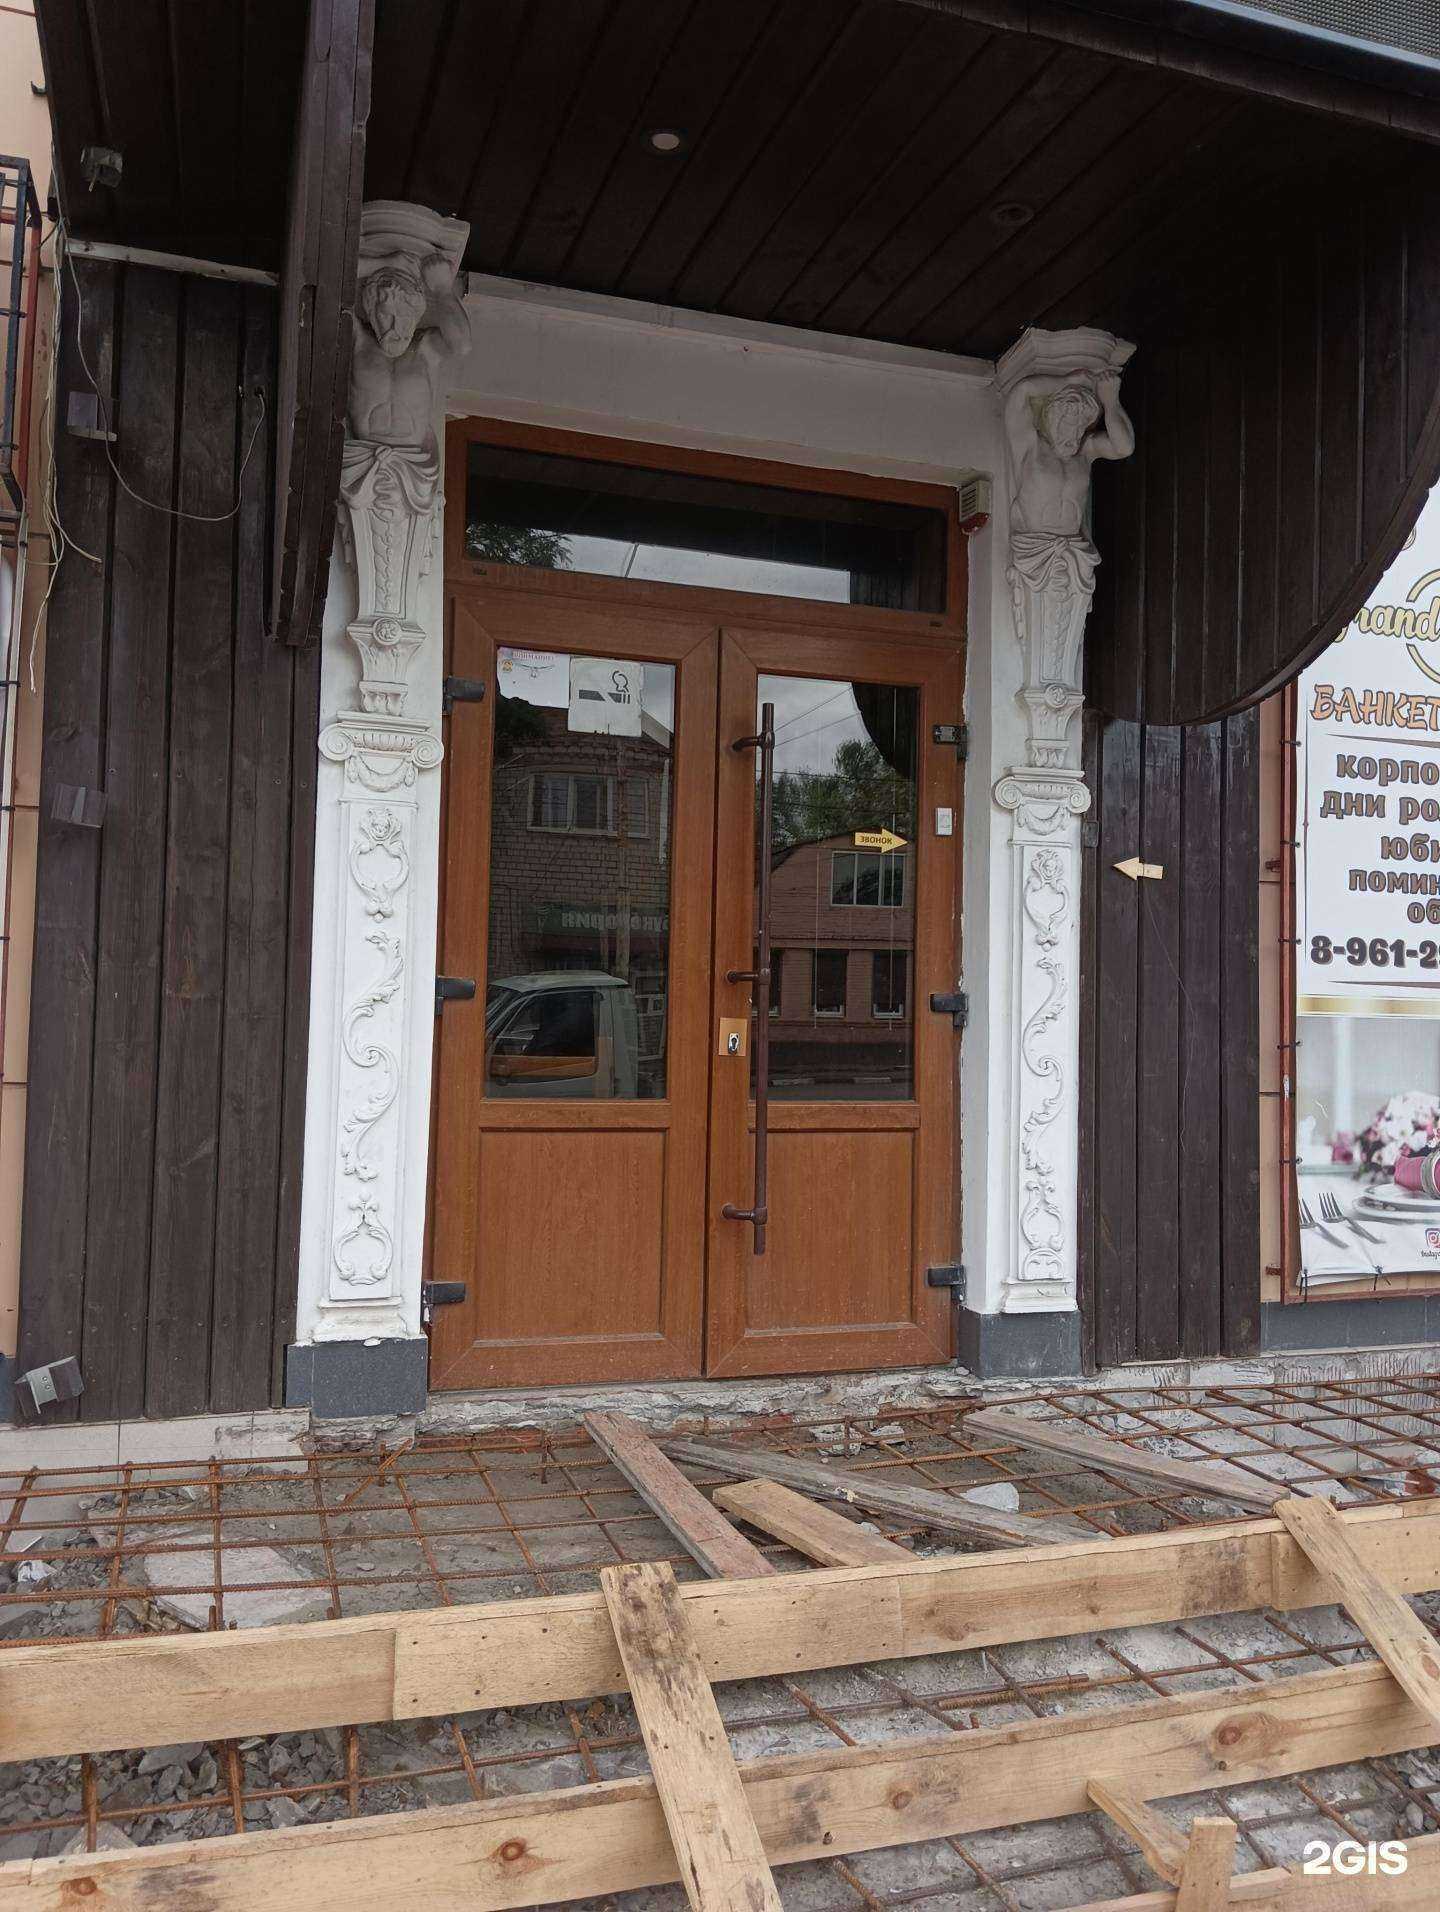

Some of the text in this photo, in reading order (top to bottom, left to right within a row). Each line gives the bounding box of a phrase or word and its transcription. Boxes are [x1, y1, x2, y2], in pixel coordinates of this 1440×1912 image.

[1333, 596, 1440, 643] rand
[1310, 684, 1440, 731] БАНКЕТ
[1320, 791, 1440, 825] дни ро
[859, 835, 893, 845] ЗВОНОК
[1310, 935, 1440, 969] 8-961-2
